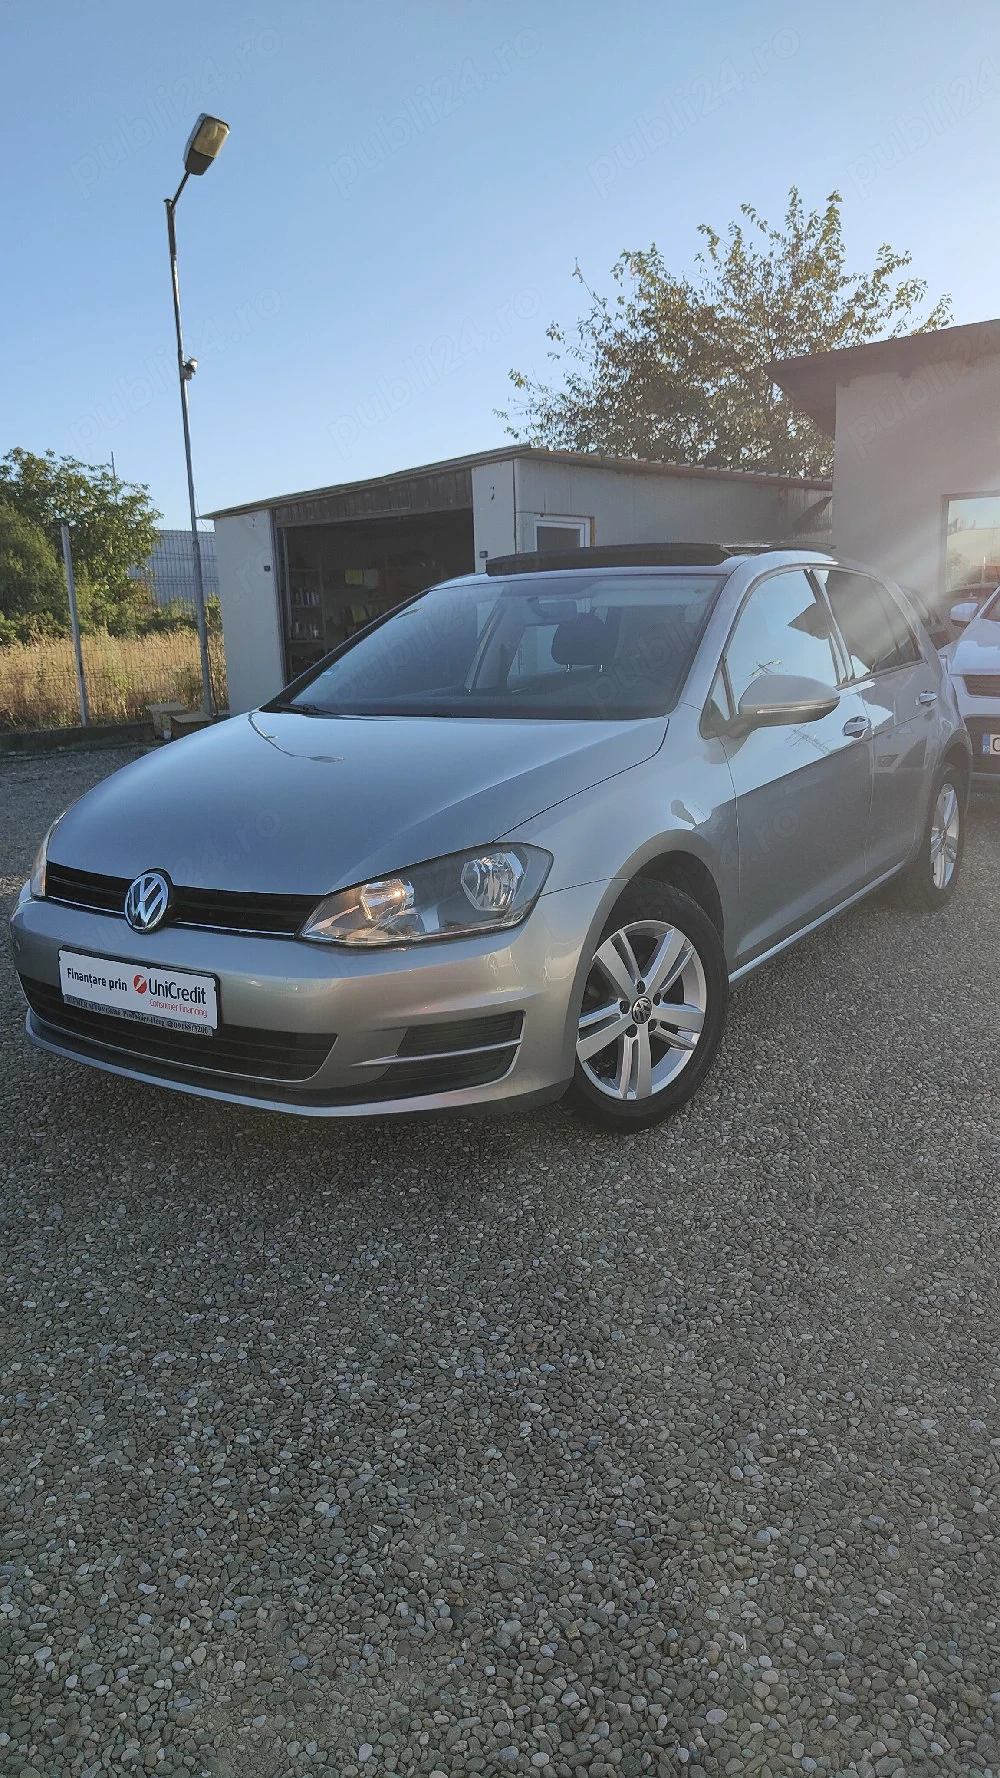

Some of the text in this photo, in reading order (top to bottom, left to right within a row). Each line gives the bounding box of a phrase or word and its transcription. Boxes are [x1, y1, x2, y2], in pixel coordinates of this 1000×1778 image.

[108, 977, 128, 992] prin
[148, 977, 207, 1005] UniCredit
[149, 998, 179, 1012] Consumer
